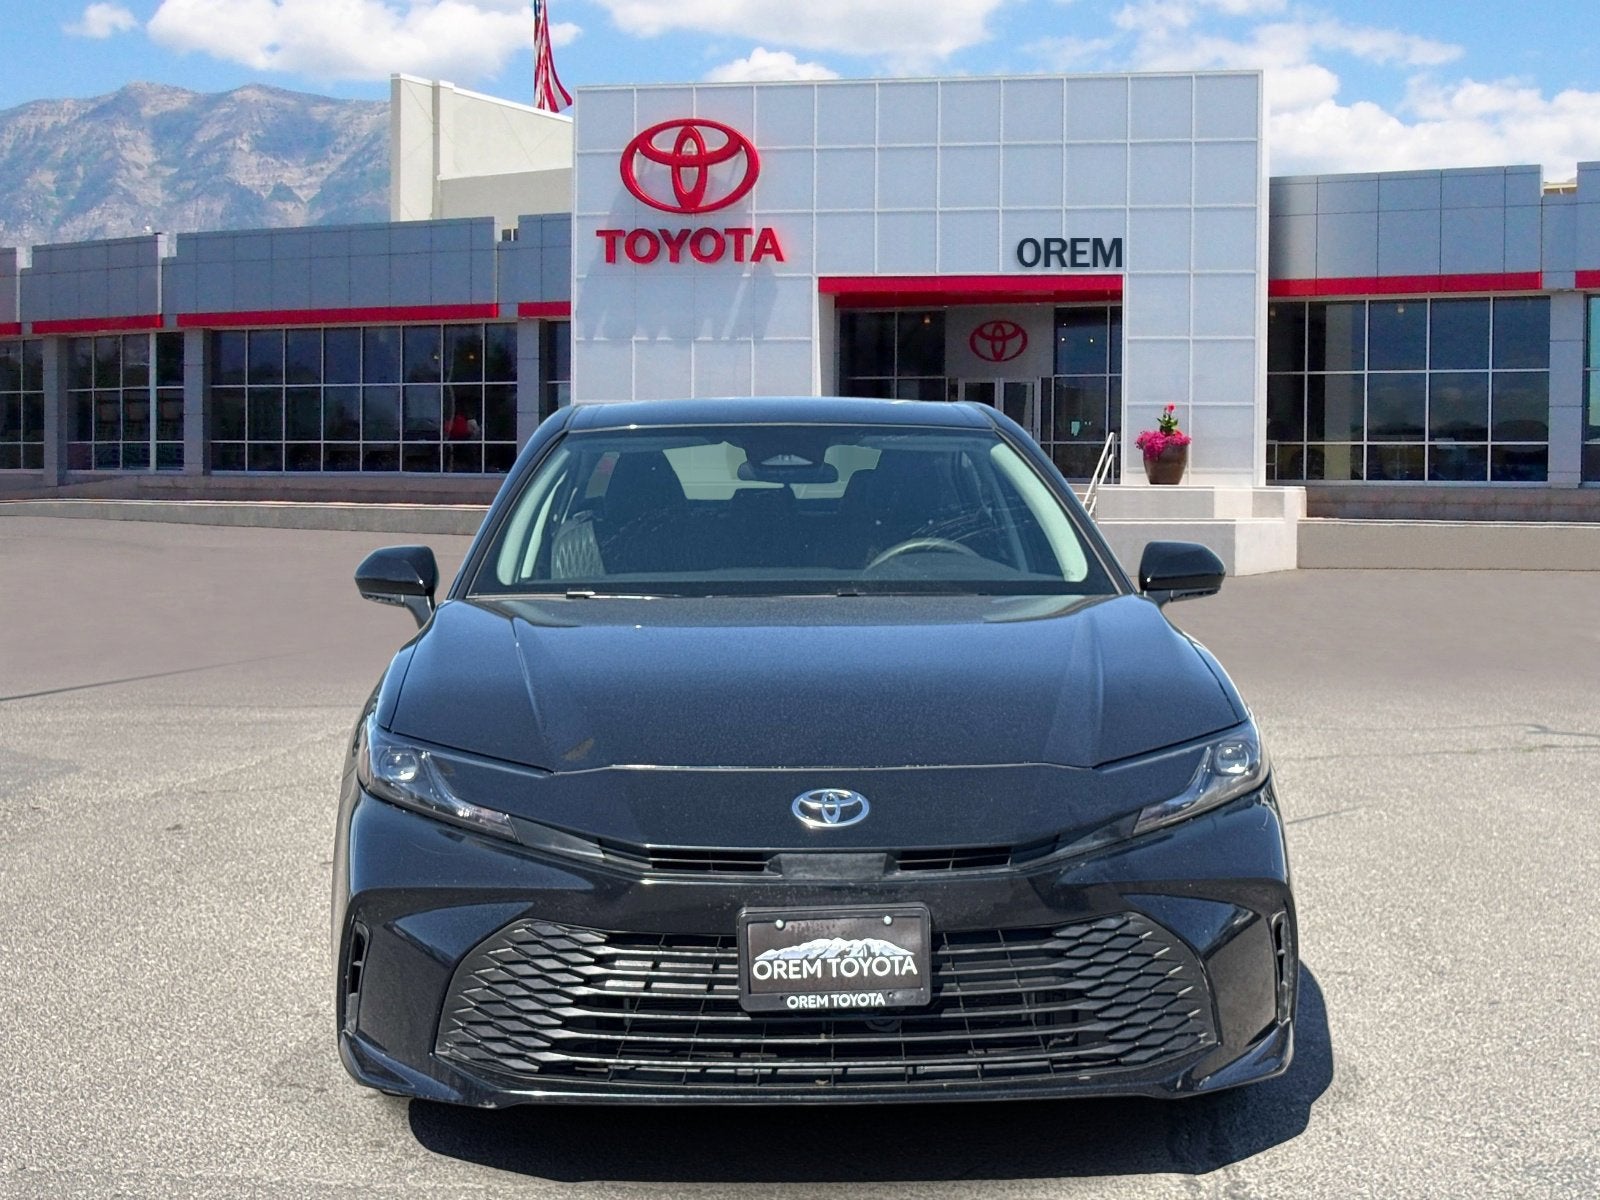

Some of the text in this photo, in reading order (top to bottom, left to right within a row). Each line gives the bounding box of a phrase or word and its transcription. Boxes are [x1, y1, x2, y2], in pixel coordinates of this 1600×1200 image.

[596, 227, 785, 264] TOYOTA
[1017, 237, 1123, 268] OREM
[753, 956, 918, 980] OREM TOYOTA
[787, 993, 886, 1009] OREM TOYOTA
